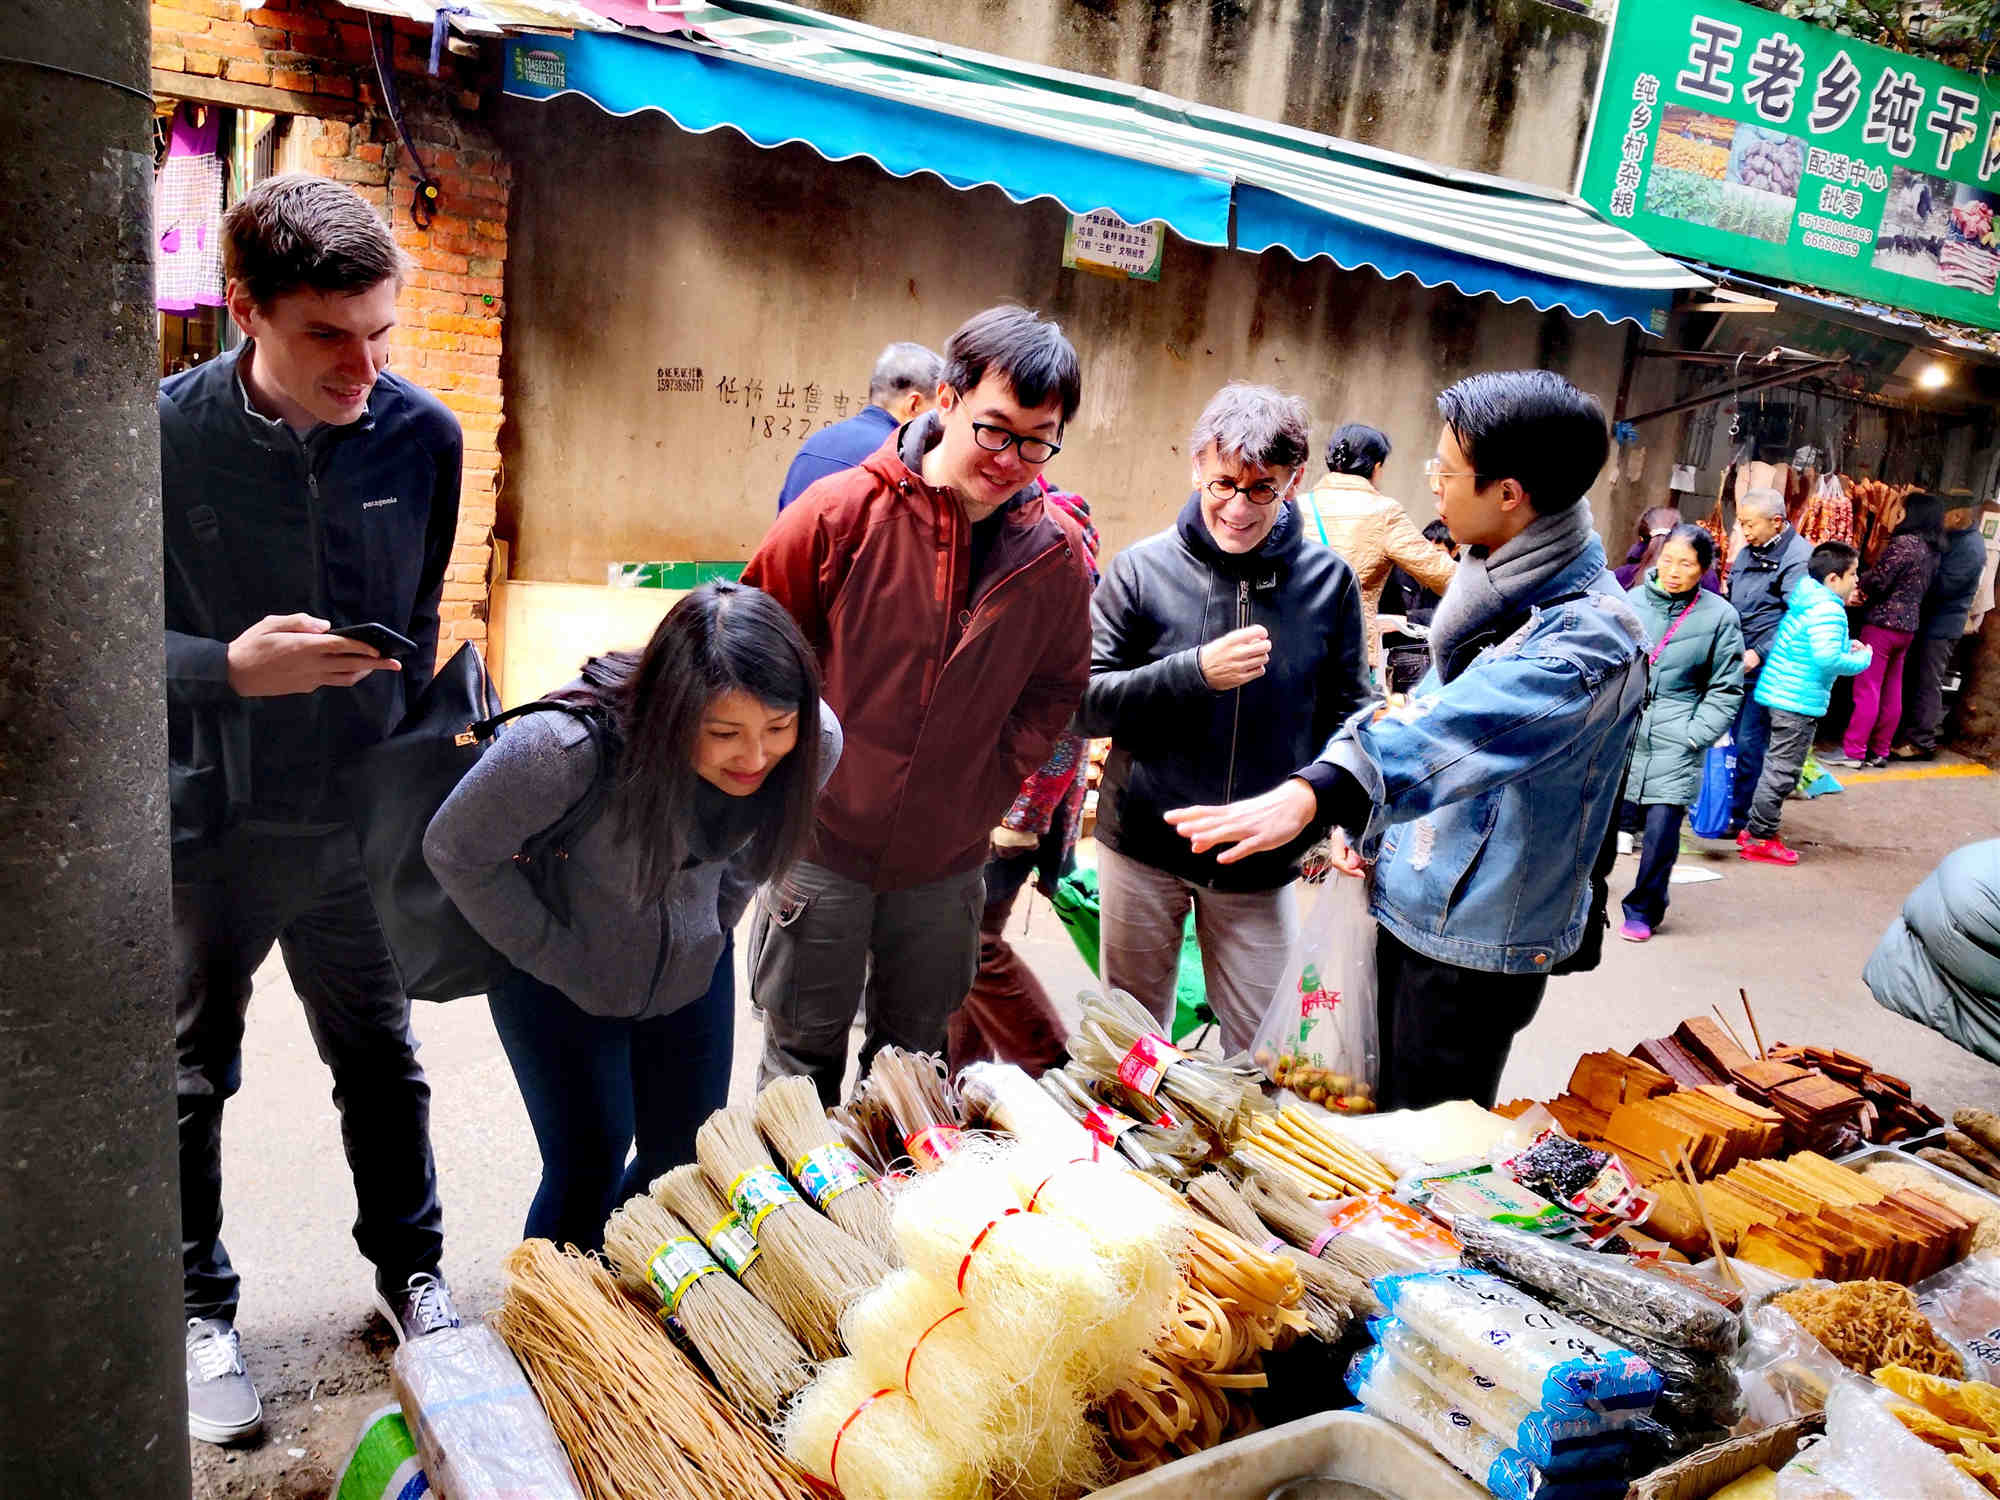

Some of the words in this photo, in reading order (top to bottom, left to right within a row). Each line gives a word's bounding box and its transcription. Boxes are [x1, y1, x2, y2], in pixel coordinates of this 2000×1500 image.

[1610, 73, 1660, 218] 纯乡村杂粮
[1807, 147, 1888, 191] 配送中心
[1819, 184, 1863, 219] 批零
